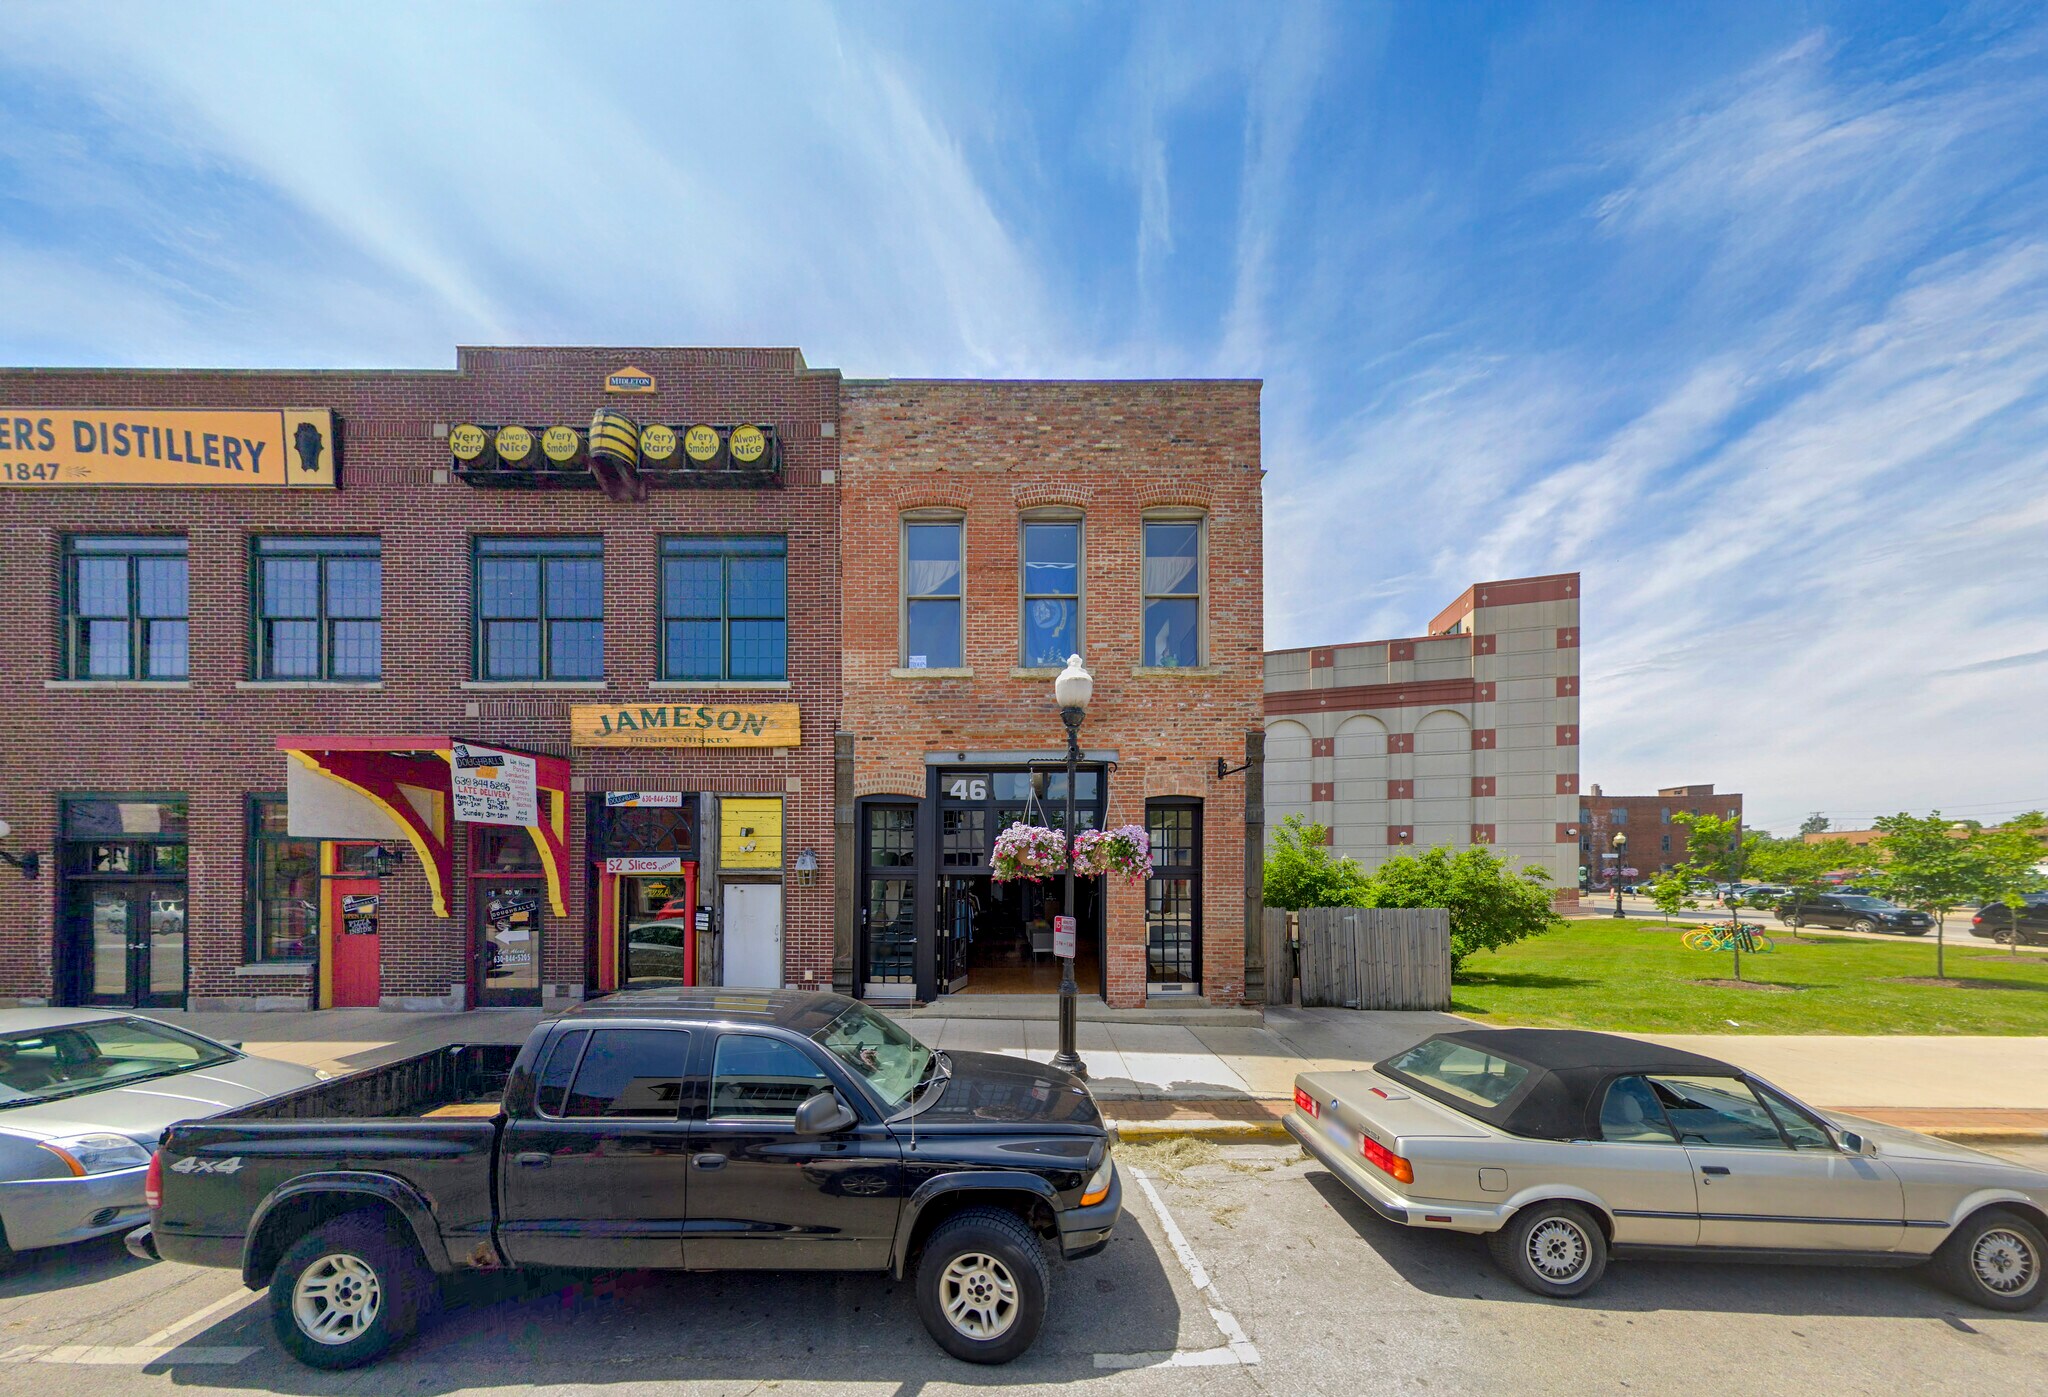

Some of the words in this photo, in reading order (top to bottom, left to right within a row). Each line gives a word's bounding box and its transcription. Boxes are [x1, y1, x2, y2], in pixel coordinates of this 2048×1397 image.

[611, 377, 650, 385] MIDLETON
[453, 430, 482, 442] Very
[500, 432, 529, 441] Always
[550, 431, 573, 441] Very
[644, 430, 674, 443] Very
[690, 430, 714, 443] Very
[734, 434, 761, 444] Always
[73, 420, 266, 473] DISTILLERY
[453, 442, 482, 452] Rare
[500, 442, 528, 452] Nice
[546, 442, 576, 453] Smooth
[644, 442, 674, 453] Rare
[688, 442, 717, 453] Smooth
[734, 445, 762, 455] Nice
[3, 463, 60, 480] 1847
[593, 706, 769, 737] JAMESON
[457, 756, 504, 768] DOUGHBALLS
[458, 786, 478, 795] LATE
[480, 787, 511, 799] DELIVERY
[950, 779, 987, 800] 46
[463, 808, 485, 818] Sunday
[608, 858, 623, 871] $2
[629, 859, 658, 871] Slices
[170, 1156, 244, 1174] 4x4
